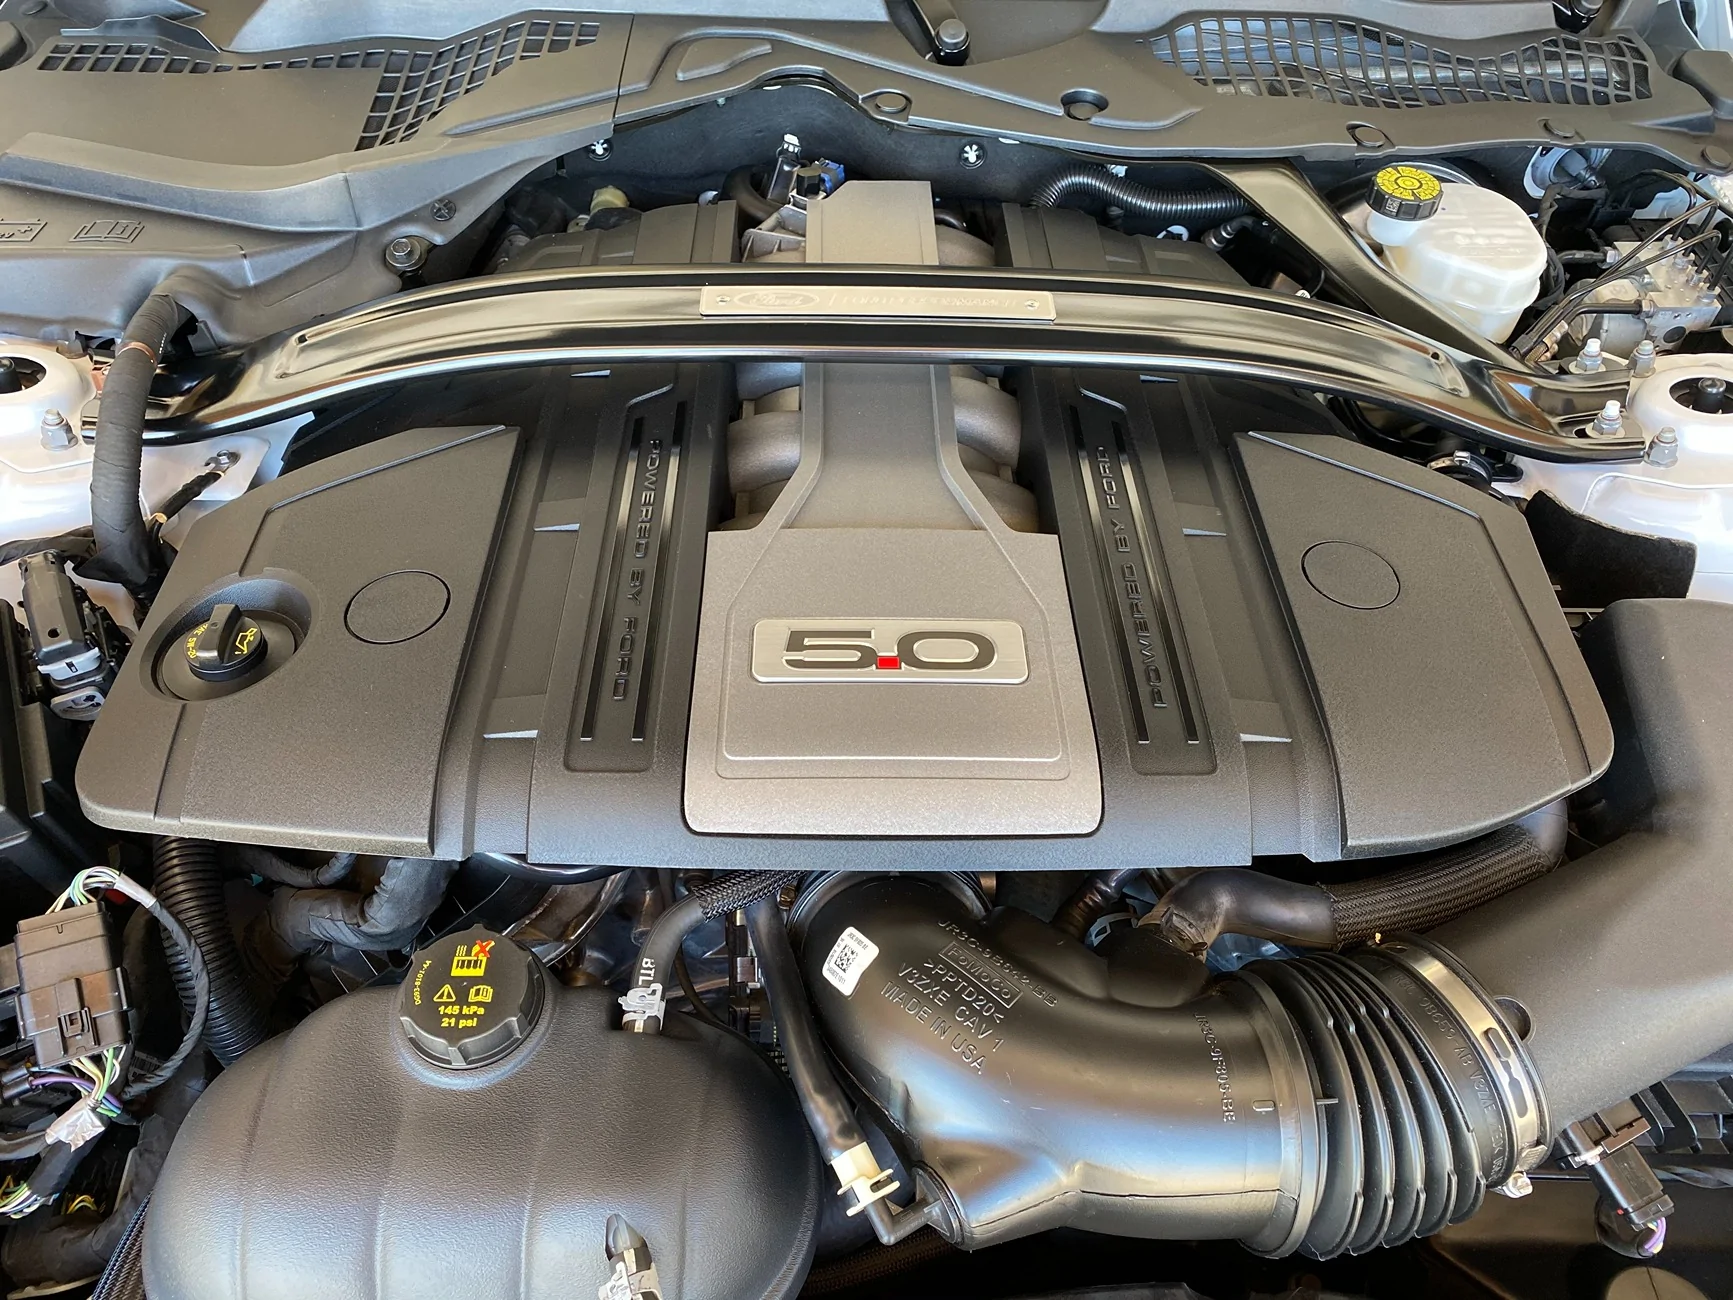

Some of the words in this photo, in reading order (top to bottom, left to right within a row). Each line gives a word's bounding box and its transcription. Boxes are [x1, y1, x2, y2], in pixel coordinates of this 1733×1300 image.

[634, 439, 661, 558] POWERED
[1097, 447, 1120, 510] FORD
[1111, 518, 1131, 553] BY
[628, 568, 644, 605] BY
[613, 616, 638, 701] FORD
[781, 628, 998, 672] 5.0
[1122, 562, 1167, 708] POWERED
[638, 957, 656, 986] BTL
[947, 947, 1012, 1000] FoMoCo
[438, 1005, 460, 1015] 145
[461, 1005, 485, 1015] kPa
[440, 1017, 456, 1027] 21
[458, 1017, 478, 1029] psi
[898, 962, 951, 1007] V3ZXE
[954, 1005, 993, 1040] CAV
[880, 980, 933, 1025] MADE
[930, 1016, 952, 1041] IN
[951, 1032, 987, 1076] USA
